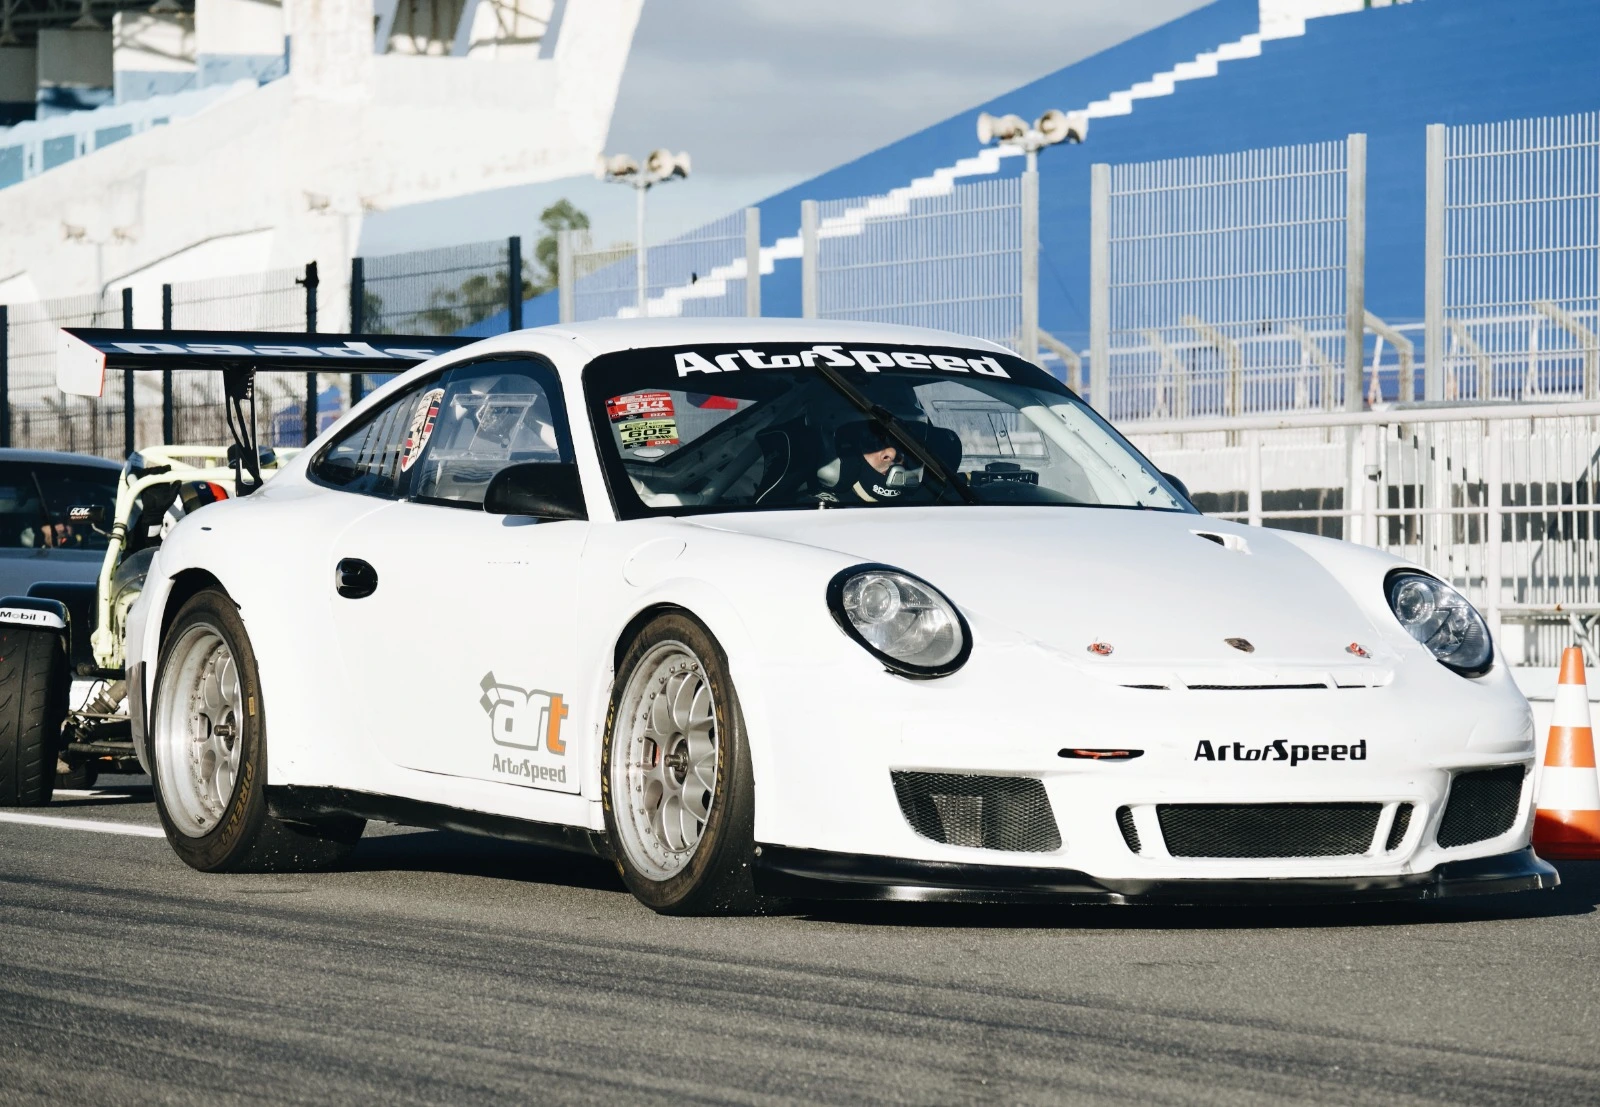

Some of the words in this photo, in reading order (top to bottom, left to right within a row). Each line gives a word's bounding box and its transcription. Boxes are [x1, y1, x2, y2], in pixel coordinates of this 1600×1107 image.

[628, 427, 671, 438] 605
[0, 611, 37, 621] Mobil
[1193, 739, 1367, 767] ArtofSpeed
[492, 753, 567, 784] ArtofSpeed
[219, 760, 254, 846] PIRELLI
